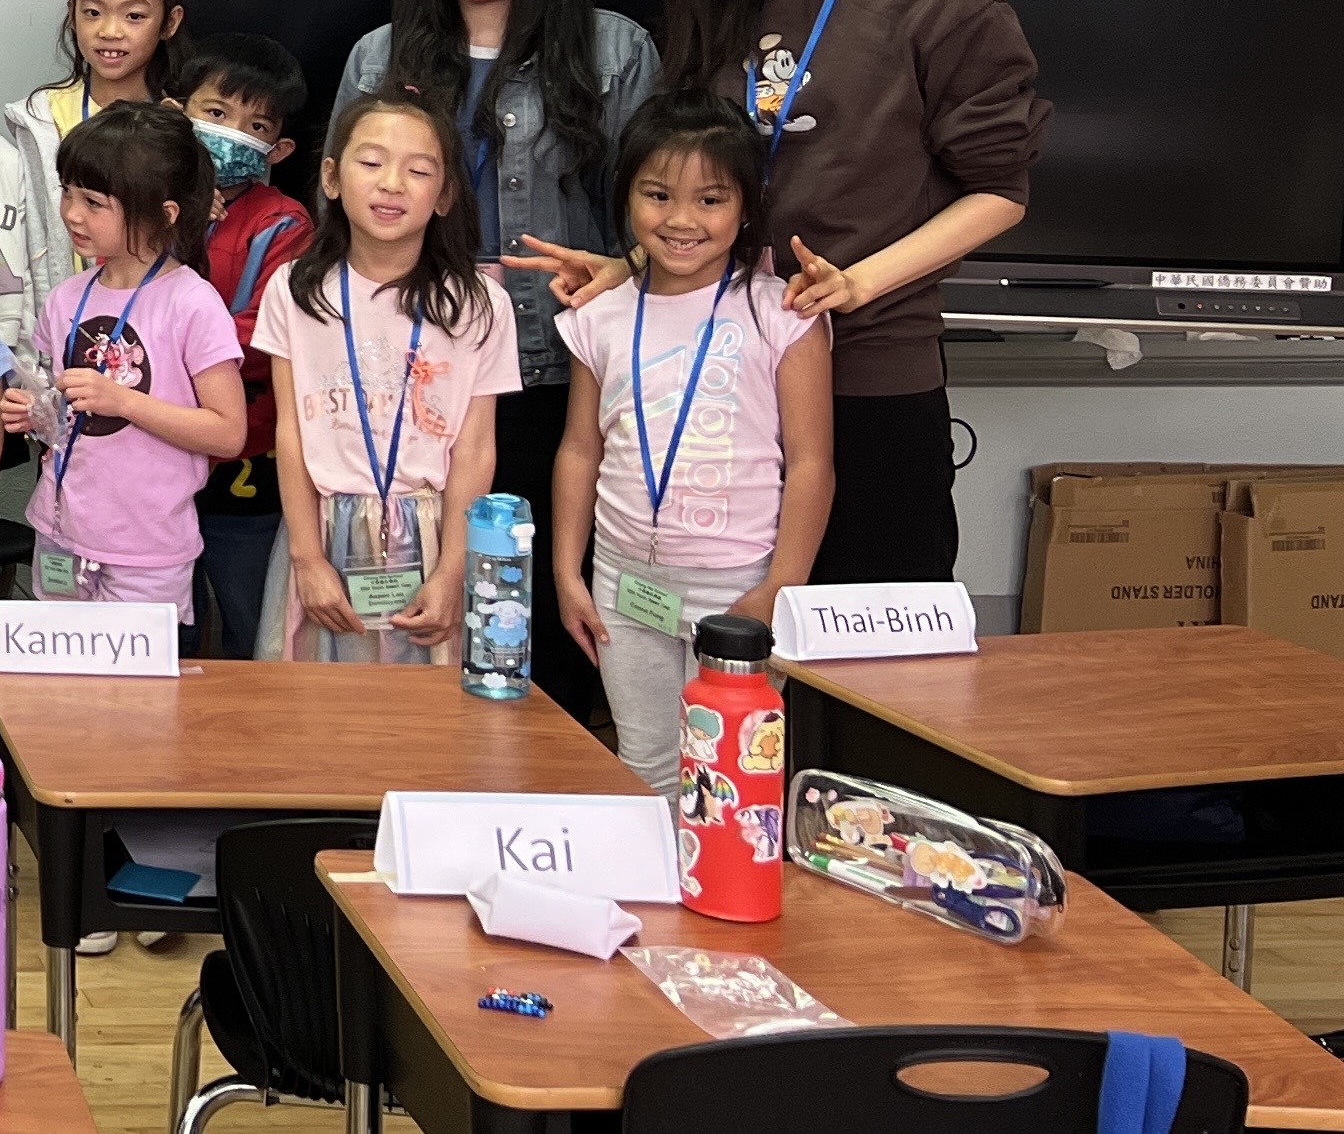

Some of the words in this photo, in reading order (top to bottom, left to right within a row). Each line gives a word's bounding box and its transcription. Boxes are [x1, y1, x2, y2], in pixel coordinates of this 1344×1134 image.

[303, 387, 351, 421] BST
[681, 321, 746, 538] adidas
[1185, 556, 1220, 570] HINA
[1111, 585, 1159, 600] STAND
[1312, 594, 1344, 609] TAND
[811, 605, 955, 634] Thai-Binh
[4, 623, 151, 664] Kamryn
[496, 827, 574, 873] Kai
